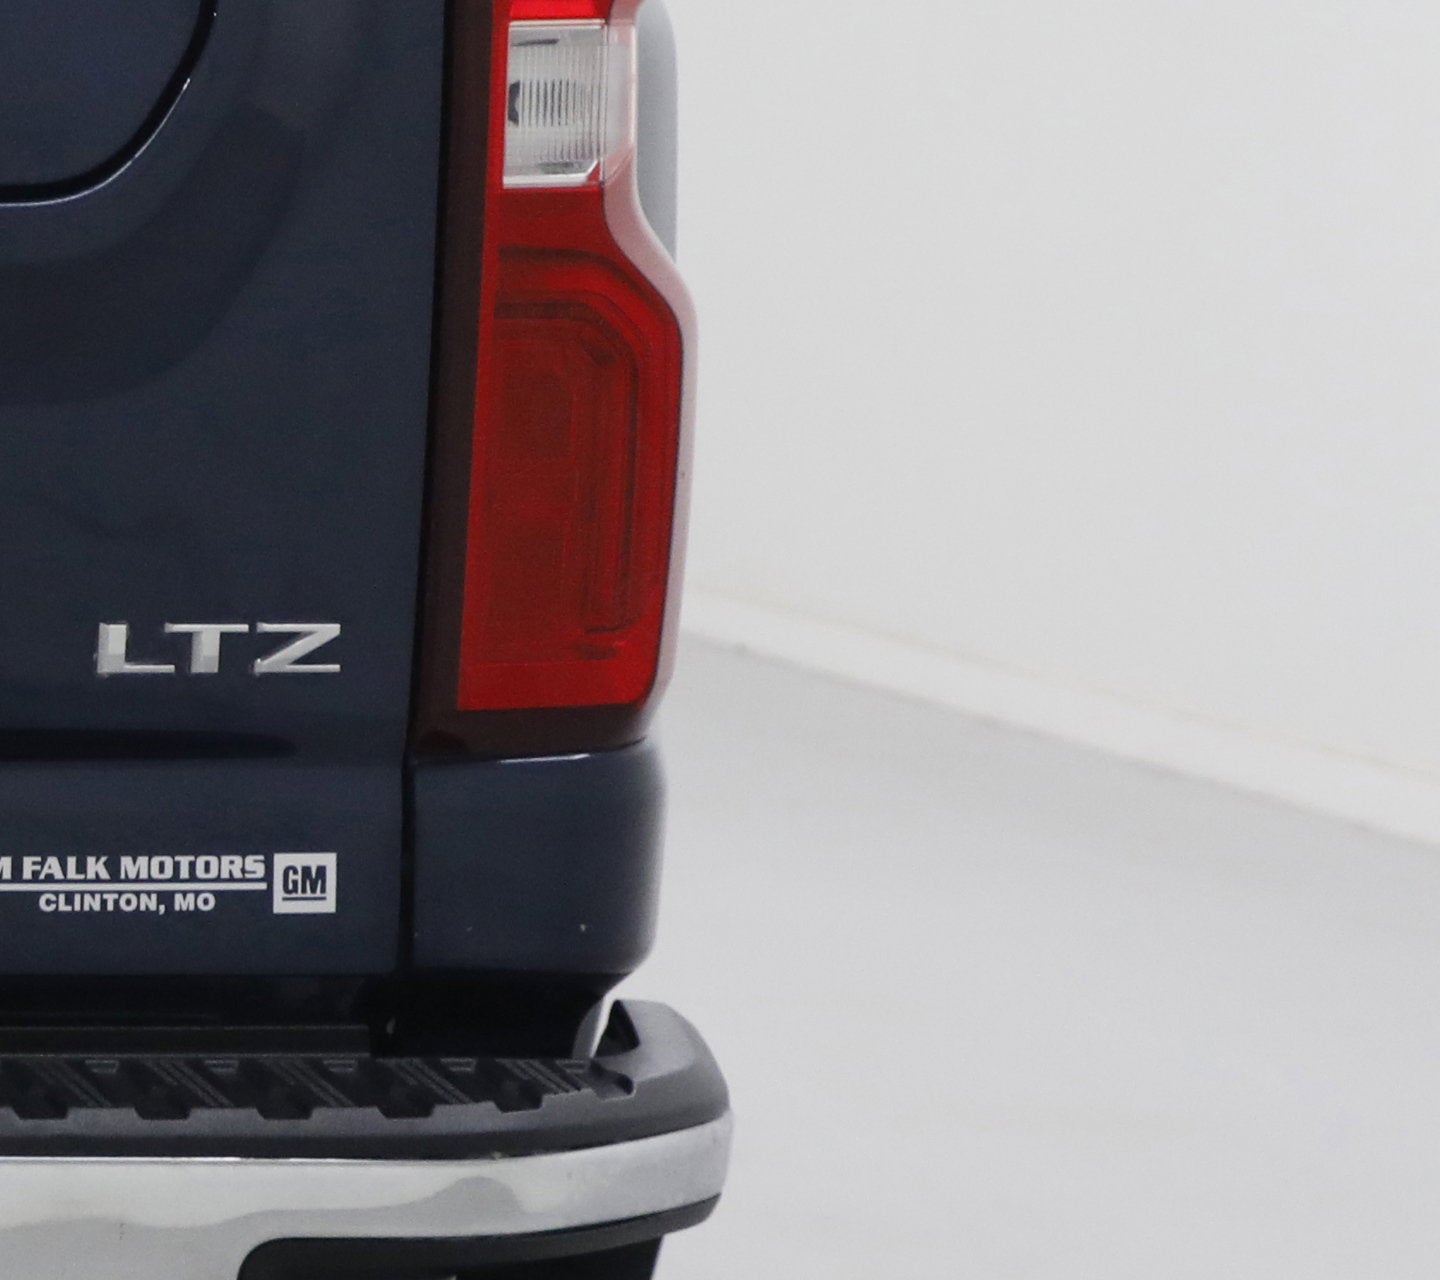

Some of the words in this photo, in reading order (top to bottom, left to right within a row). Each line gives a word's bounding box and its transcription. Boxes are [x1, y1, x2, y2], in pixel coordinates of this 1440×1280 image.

[96, 622, 341, 675] LTZ
[23, 856, 109, 880] FALK
[119, 855, 266, 880] MOTORS
[281, 864, 327, 896] GM
[38, 892, 166, 915] CLINTON,
[174, 893, 216, 912] MO
